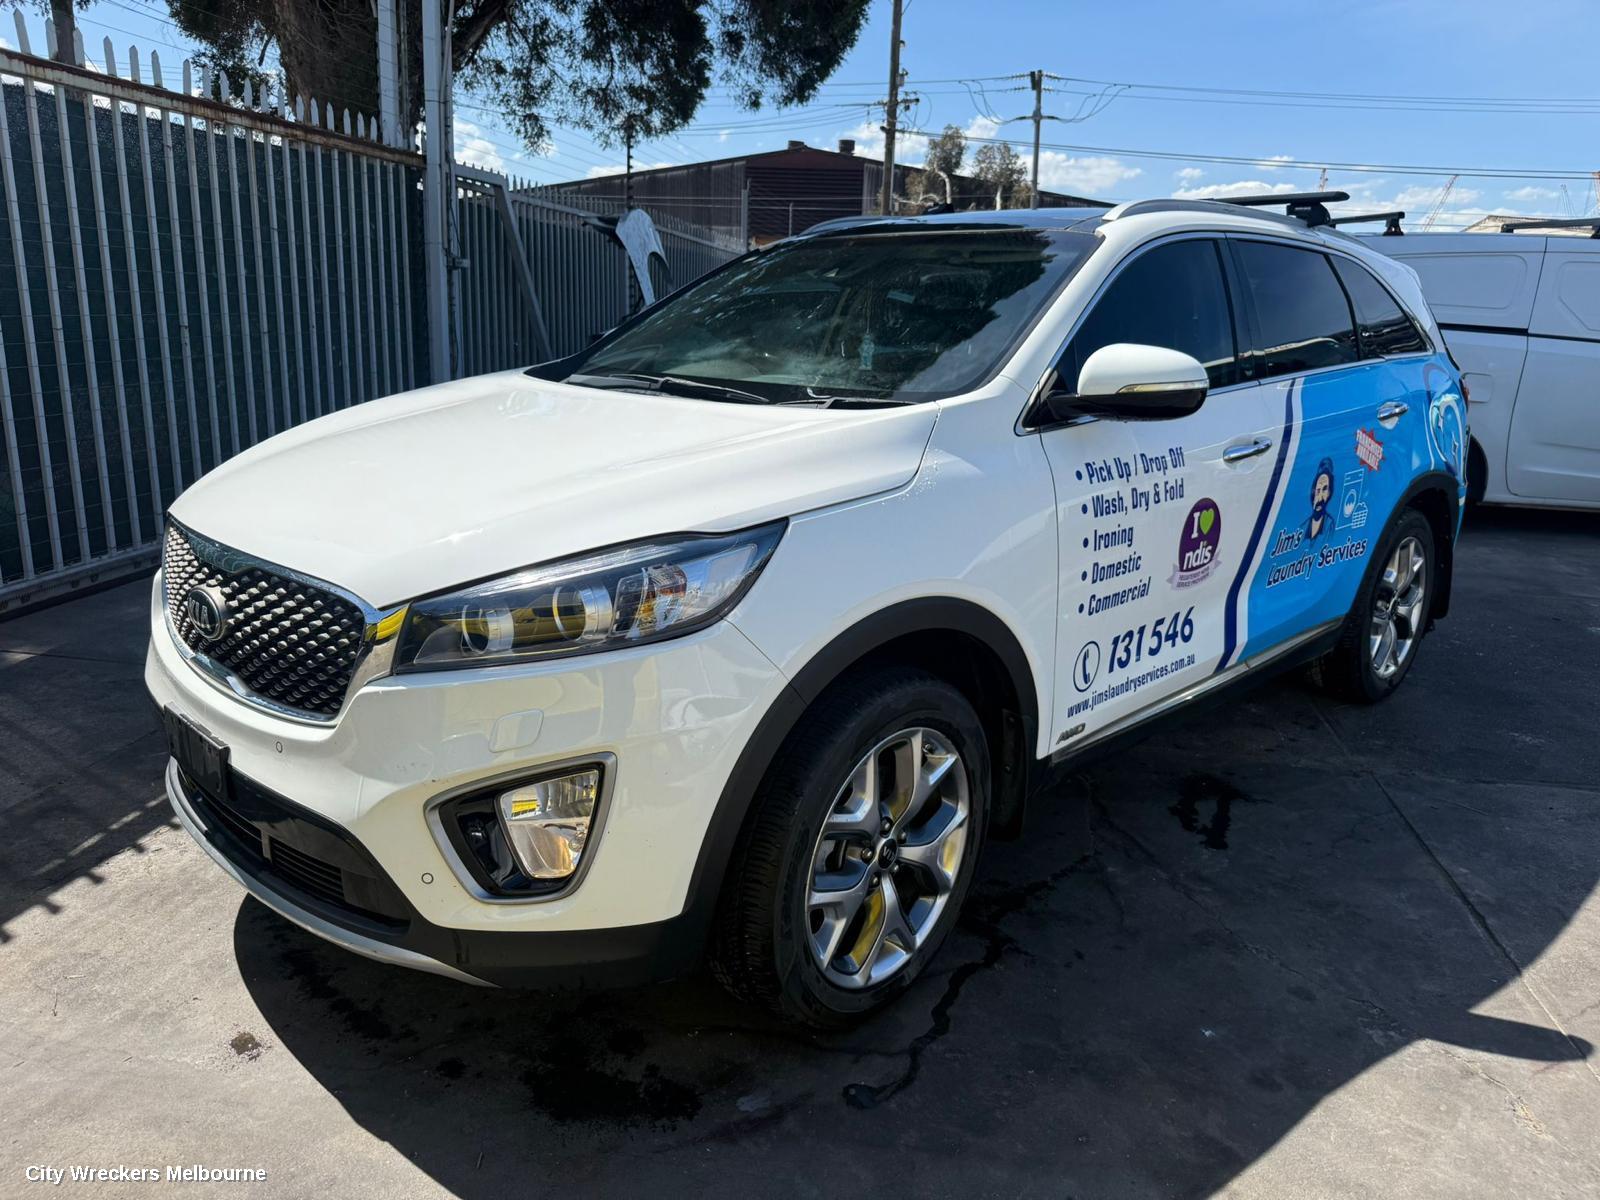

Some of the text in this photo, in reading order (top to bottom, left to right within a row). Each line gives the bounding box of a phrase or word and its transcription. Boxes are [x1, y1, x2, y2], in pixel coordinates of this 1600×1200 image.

[1085, 460, 1114, 484] Pick
[1113, 457, 1131, 483] Up
[1140, 452, 1168, 476] Drop
[1168, 446, 1185, 470] Off
[1092, 477, 1184, 518] Wash, Dry & Fold
[1093, 524, 1134, 552] Ironing
[1191, 511, 1200, 539] I
[1183, 541, 1213, 570] ndis
[1270, 528, 1304, 558] Jim's
[1091, 552, 1142, 585] Domestic
[1266, 536, 1367, 588] Laundry Services
[1088, 576, 1152, 616] Commercial
[1067, 653, 1195, 718] www.jimslaundryservices.com.au
